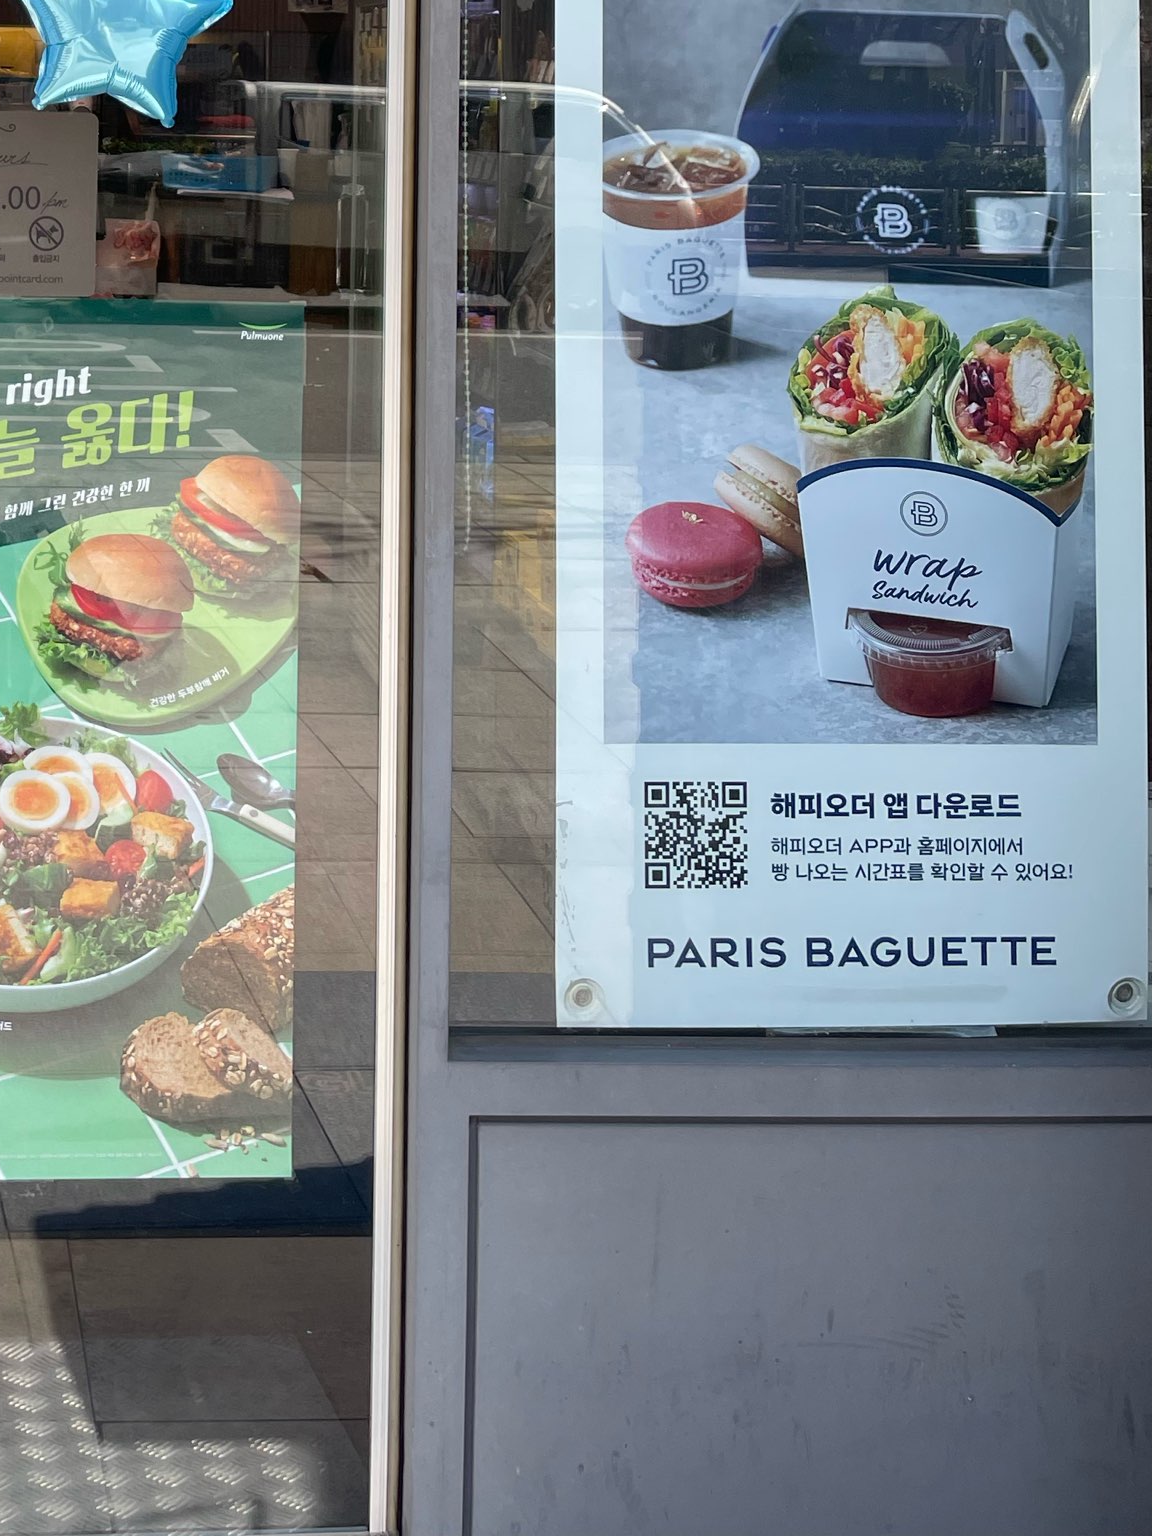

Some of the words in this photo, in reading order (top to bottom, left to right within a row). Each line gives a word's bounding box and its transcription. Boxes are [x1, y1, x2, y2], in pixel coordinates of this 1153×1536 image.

[240, 330, 284, 342] Pulmuone
[6, 366, 92, 410] right
[62, 390, 195, 468] 옳다!
[4, 500, 33, 520] 함께
[38, 494, 66, 514] 그린
[119, 481, 133, 498] 한
[874, 548, 984, 591] wrap
[872, 580, 979, 611] Sandwich
[770, 791, 876, 820] 해피오더
[883, 793, 908, 820] 앱
[915, 793, 1023, 820] 다운로드
[771, 836, 842, 855] 해피오더
[849, 836, 910, 856] APP과
[917, 836, 1024, 856] 홈페이지에서
[771, 863, 790, 882] 빵
[795, 863, 847, 882] 나오는
[854, 863, 925, 882] 시간표를
[930, 863, 984, 882] 확인할
[991, 863, 1008, 882] 수
[1014, 863, 1073, 882] 있어요!
[647, 937, 787, 969] PARIS
[806, 936, 1057, 967] BAGUETTE
